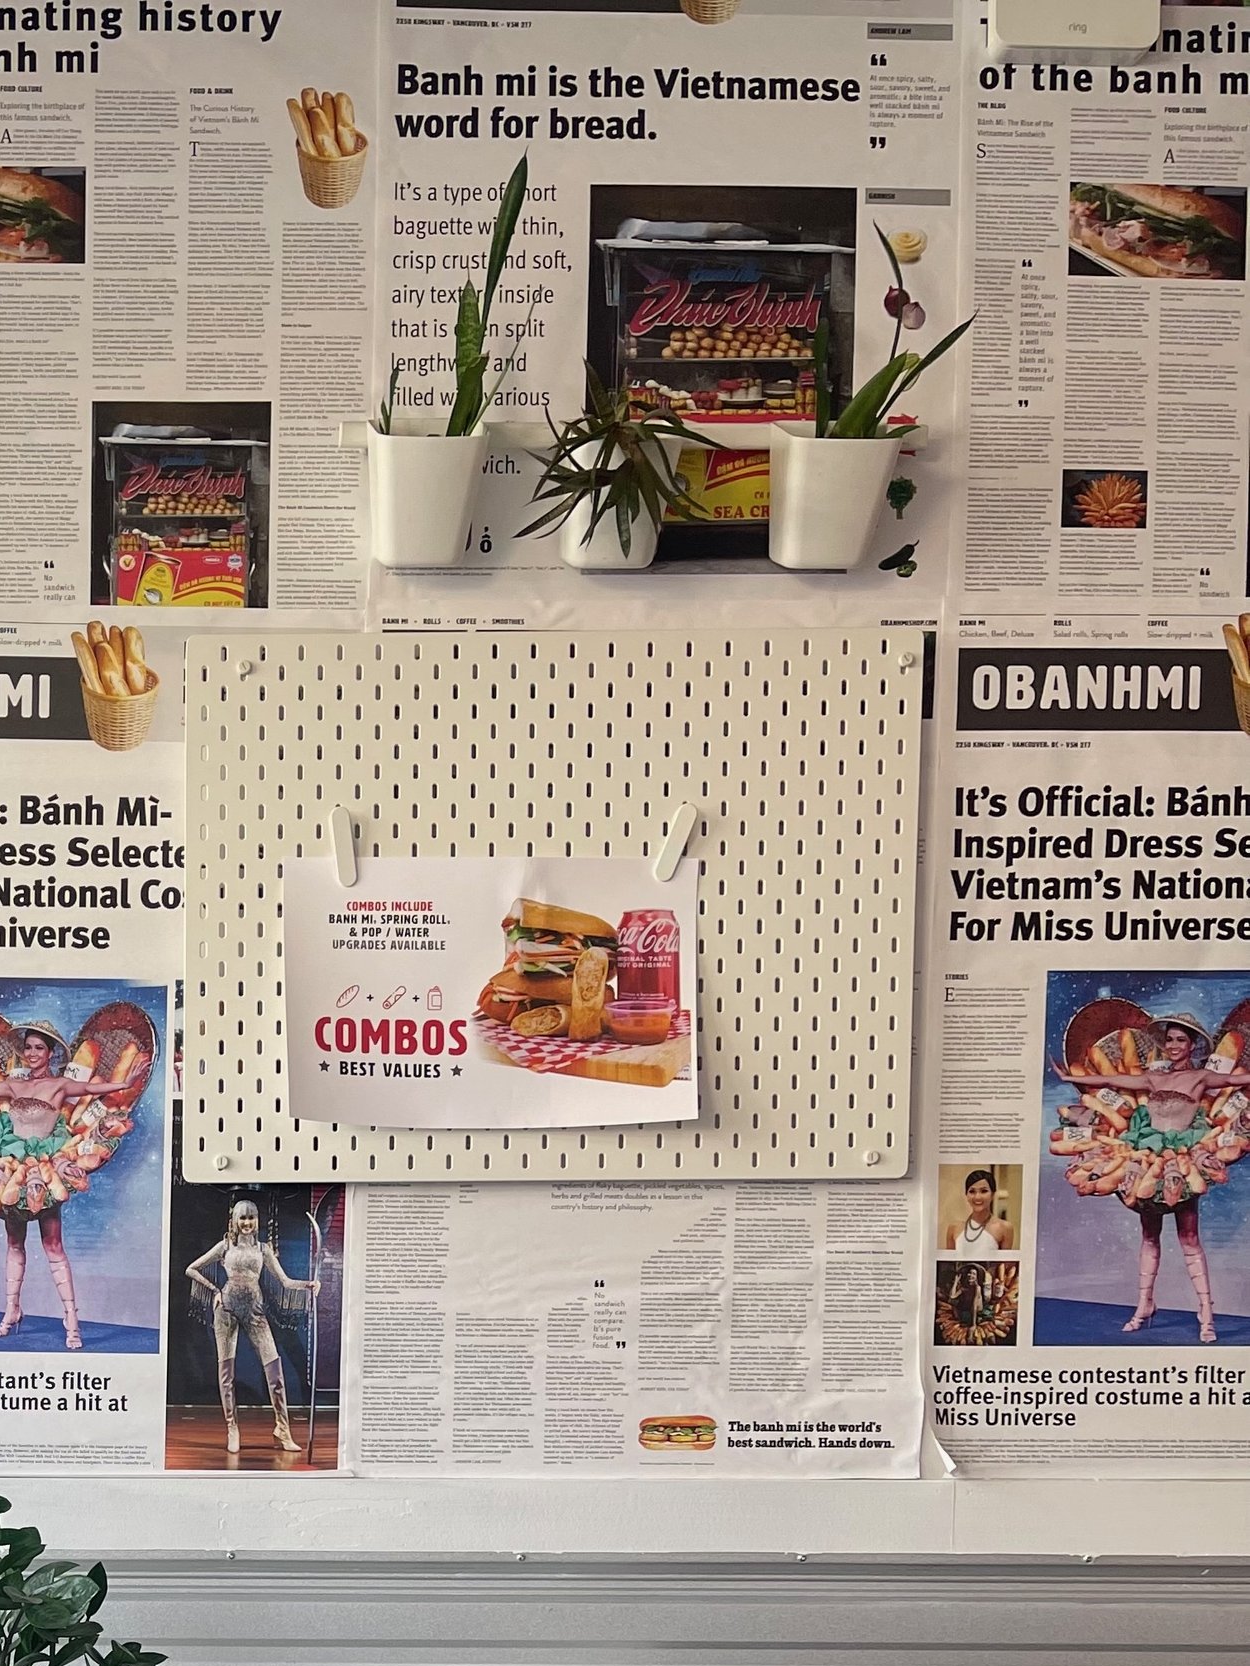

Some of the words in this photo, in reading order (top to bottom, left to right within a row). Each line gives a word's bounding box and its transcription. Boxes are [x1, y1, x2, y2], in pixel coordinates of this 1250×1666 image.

[139, 0, 282, 42] history
[1069, 23, 1087, 34] ring
[56, 41, 98, 73] mi
[398, 64, 483, 95] Banh
[496, 65, 536, 96] mi
[549, 65, 577, 97] is
[589, 67, 644, 98] the
[654, 67, 860, 102] Vietnamese
[395, 107, 479, 138] word
[490, 106, 539, 138] for
[550, 107, 656, 140] bread.
[973, 665, 1201, 710] OBANHMI
[20, 794, 103, 825] Bánh
[116, 796, 172, 826] Mì-
[347, 901, 387, 911] COMBOS
[391, 901, 433, 911] INCLUDE
[329, 914, 357, 924] BANH
[381, 915, 418, 924] SPRING
[349, 927, 357, 937] &
[362, 927, 382, 937] POP
[386, 927, 391, 937] /
[395, 928, 429, 937] WATER
[333, 940, 386, 950] UPGRADES
[390, 940, 445, 950] AVAILABLE
[315, 1017, 467, 1056] COMBOS
[340, 1061, 375, 1076] BEST
[383, 1063, 440, 1078] VALUES
[62, 1372, 111, 1390] filter
[57, 1398, 68, 1411] a
[76, 1393, 102, 1411] hit
[109, 1395, 127, 1411] at
